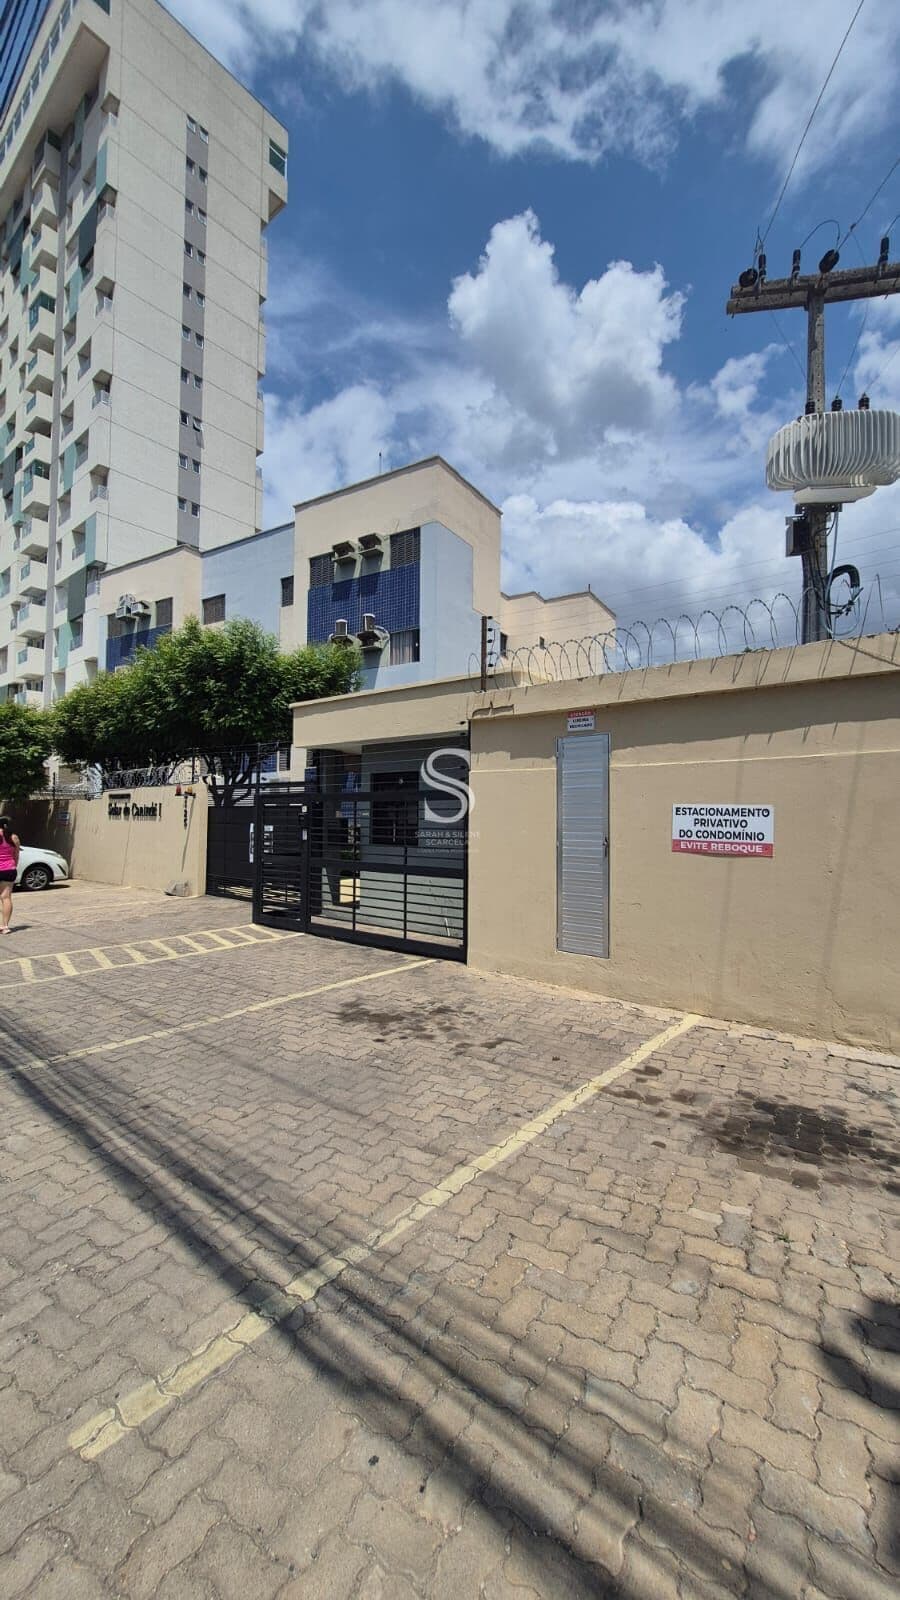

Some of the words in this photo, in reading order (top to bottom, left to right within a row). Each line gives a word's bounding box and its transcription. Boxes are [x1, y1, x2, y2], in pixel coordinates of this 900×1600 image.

[675, 807, 770, 818] ESTACIONAMENTO
[693, 818, 748, 829] PRIVATIVO
[679, 829, 693, 838] DO
[695, 830, 765, 841] CONDOMÍNIO
[680, 841, 708, 850] EVITE
[710, 843, 763, 854] REBOQUE
